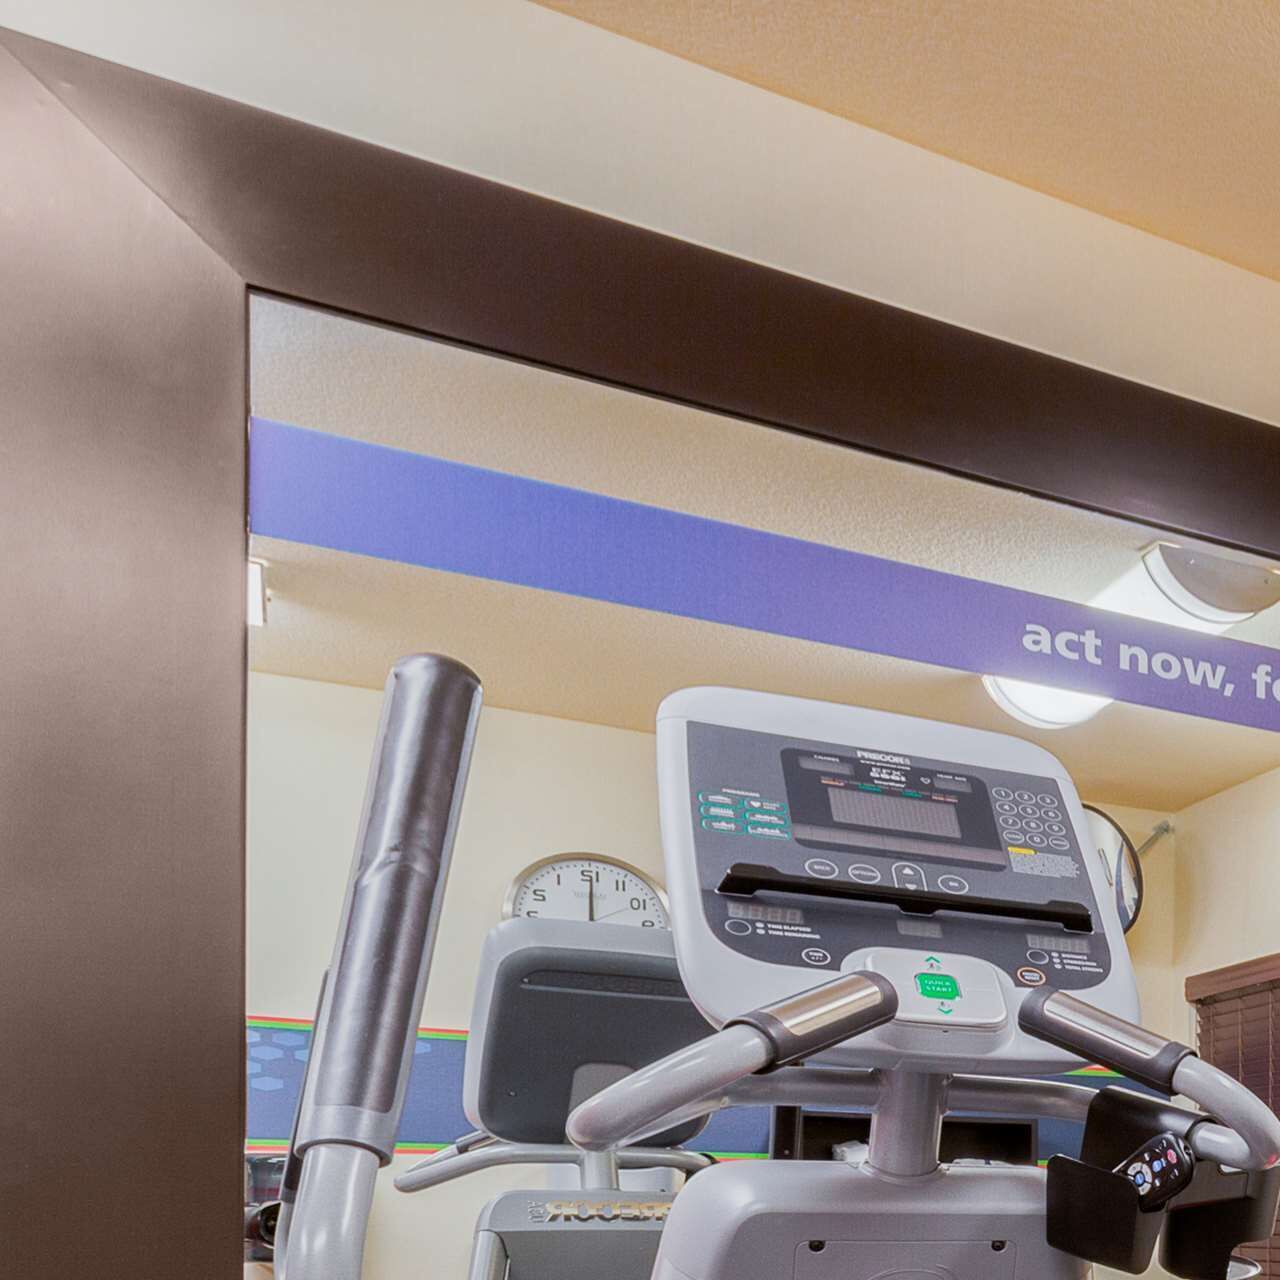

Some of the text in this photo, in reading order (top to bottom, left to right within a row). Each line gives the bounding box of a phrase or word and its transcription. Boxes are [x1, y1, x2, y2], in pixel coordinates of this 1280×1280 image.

[1021, 622, 1102, 665] act
[1118, 643, 1236, 697] now,
[856, 750, 904, 764] PRECOR
